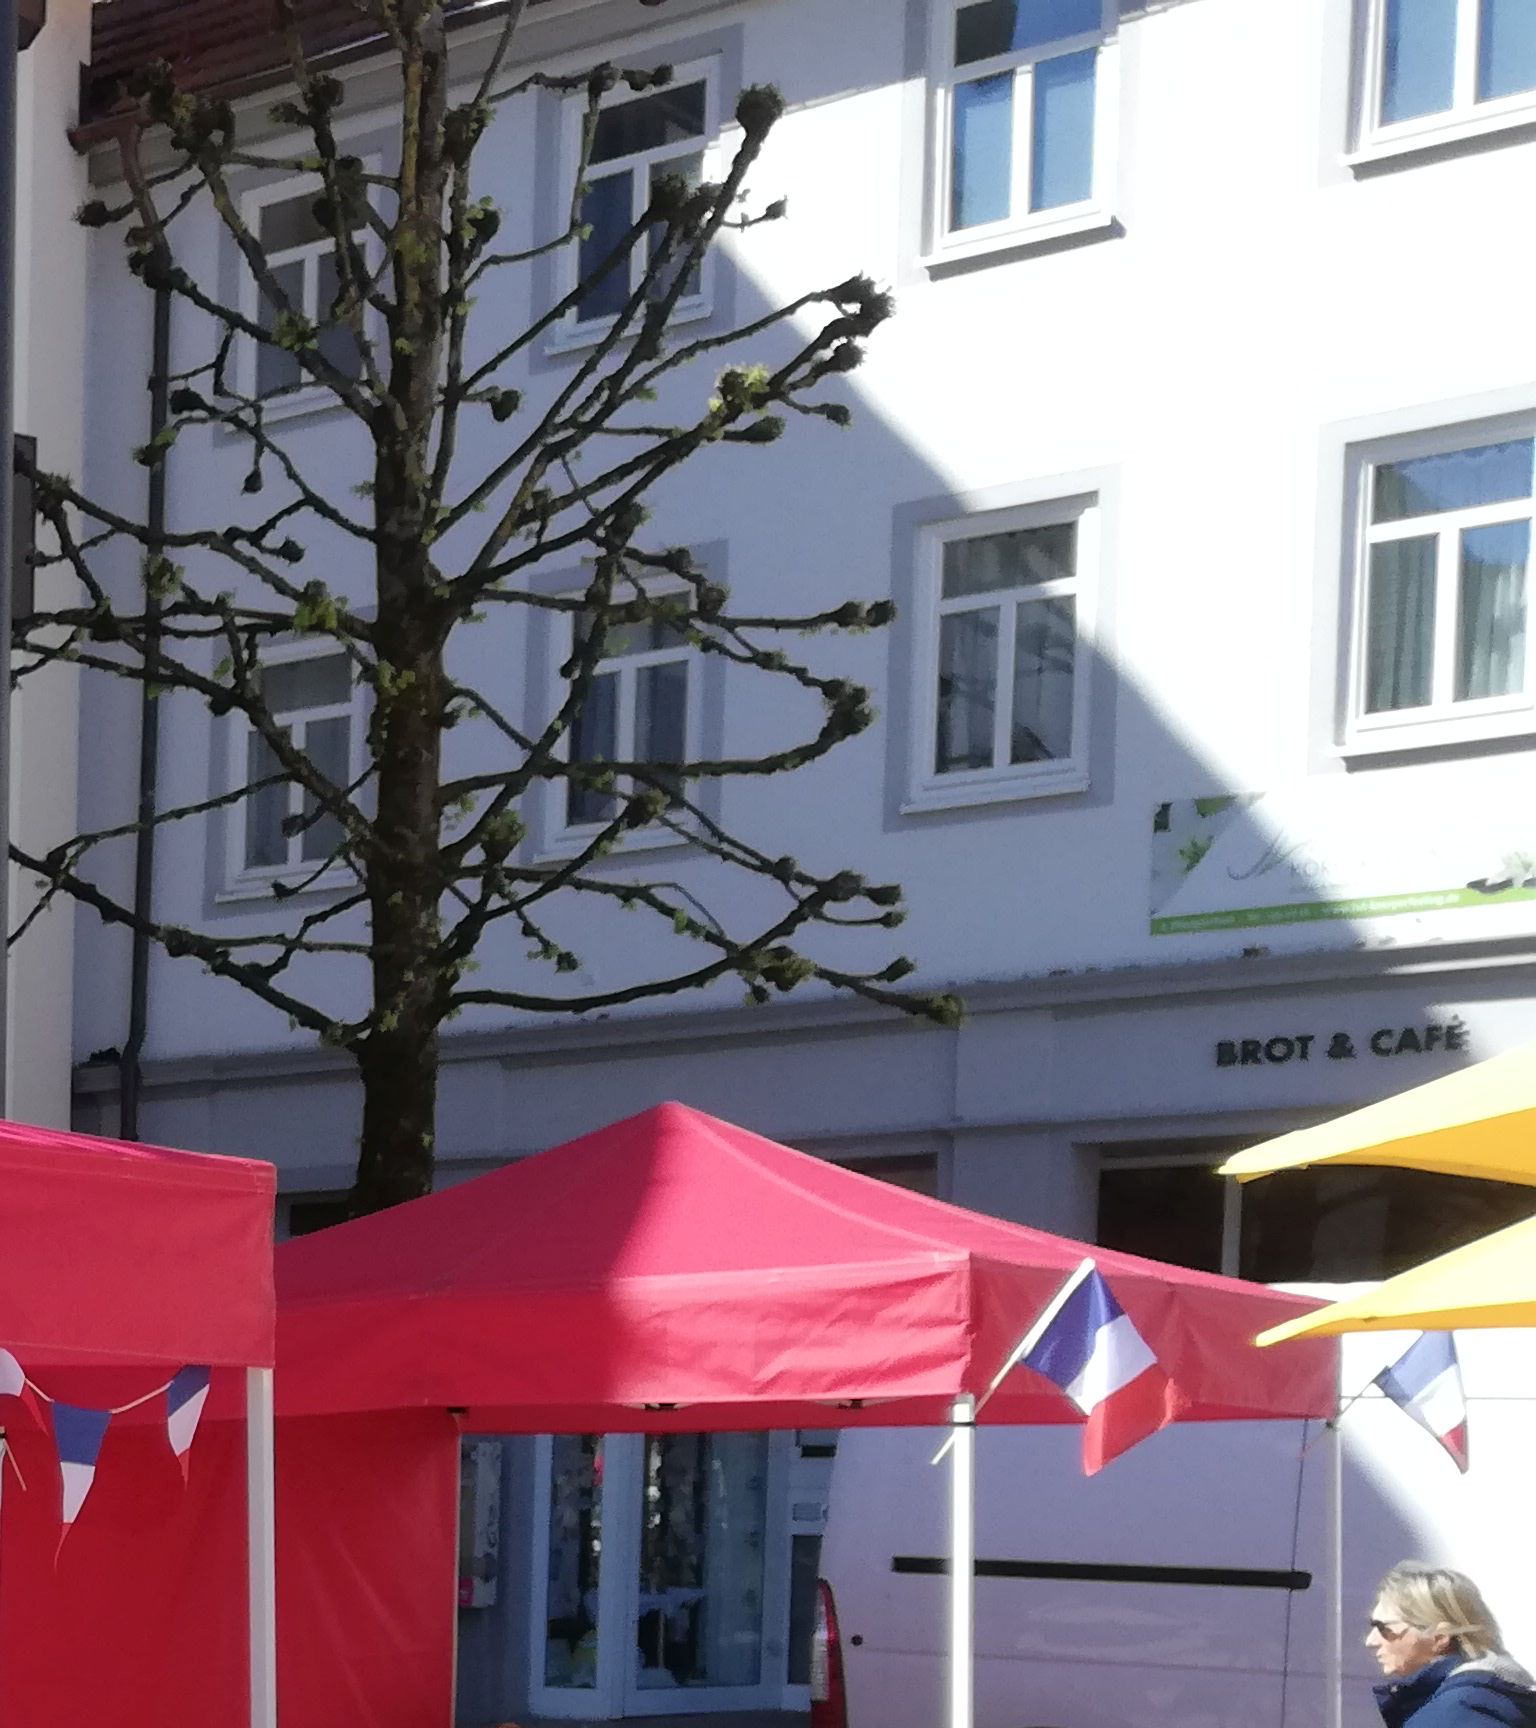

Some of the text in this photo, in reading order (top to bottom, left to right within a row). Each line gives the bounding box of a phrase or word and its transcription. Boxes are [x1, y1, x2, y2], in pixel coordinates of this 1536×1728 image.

[1216, 1014, 1469, 1067] BROT & CAFÉ
